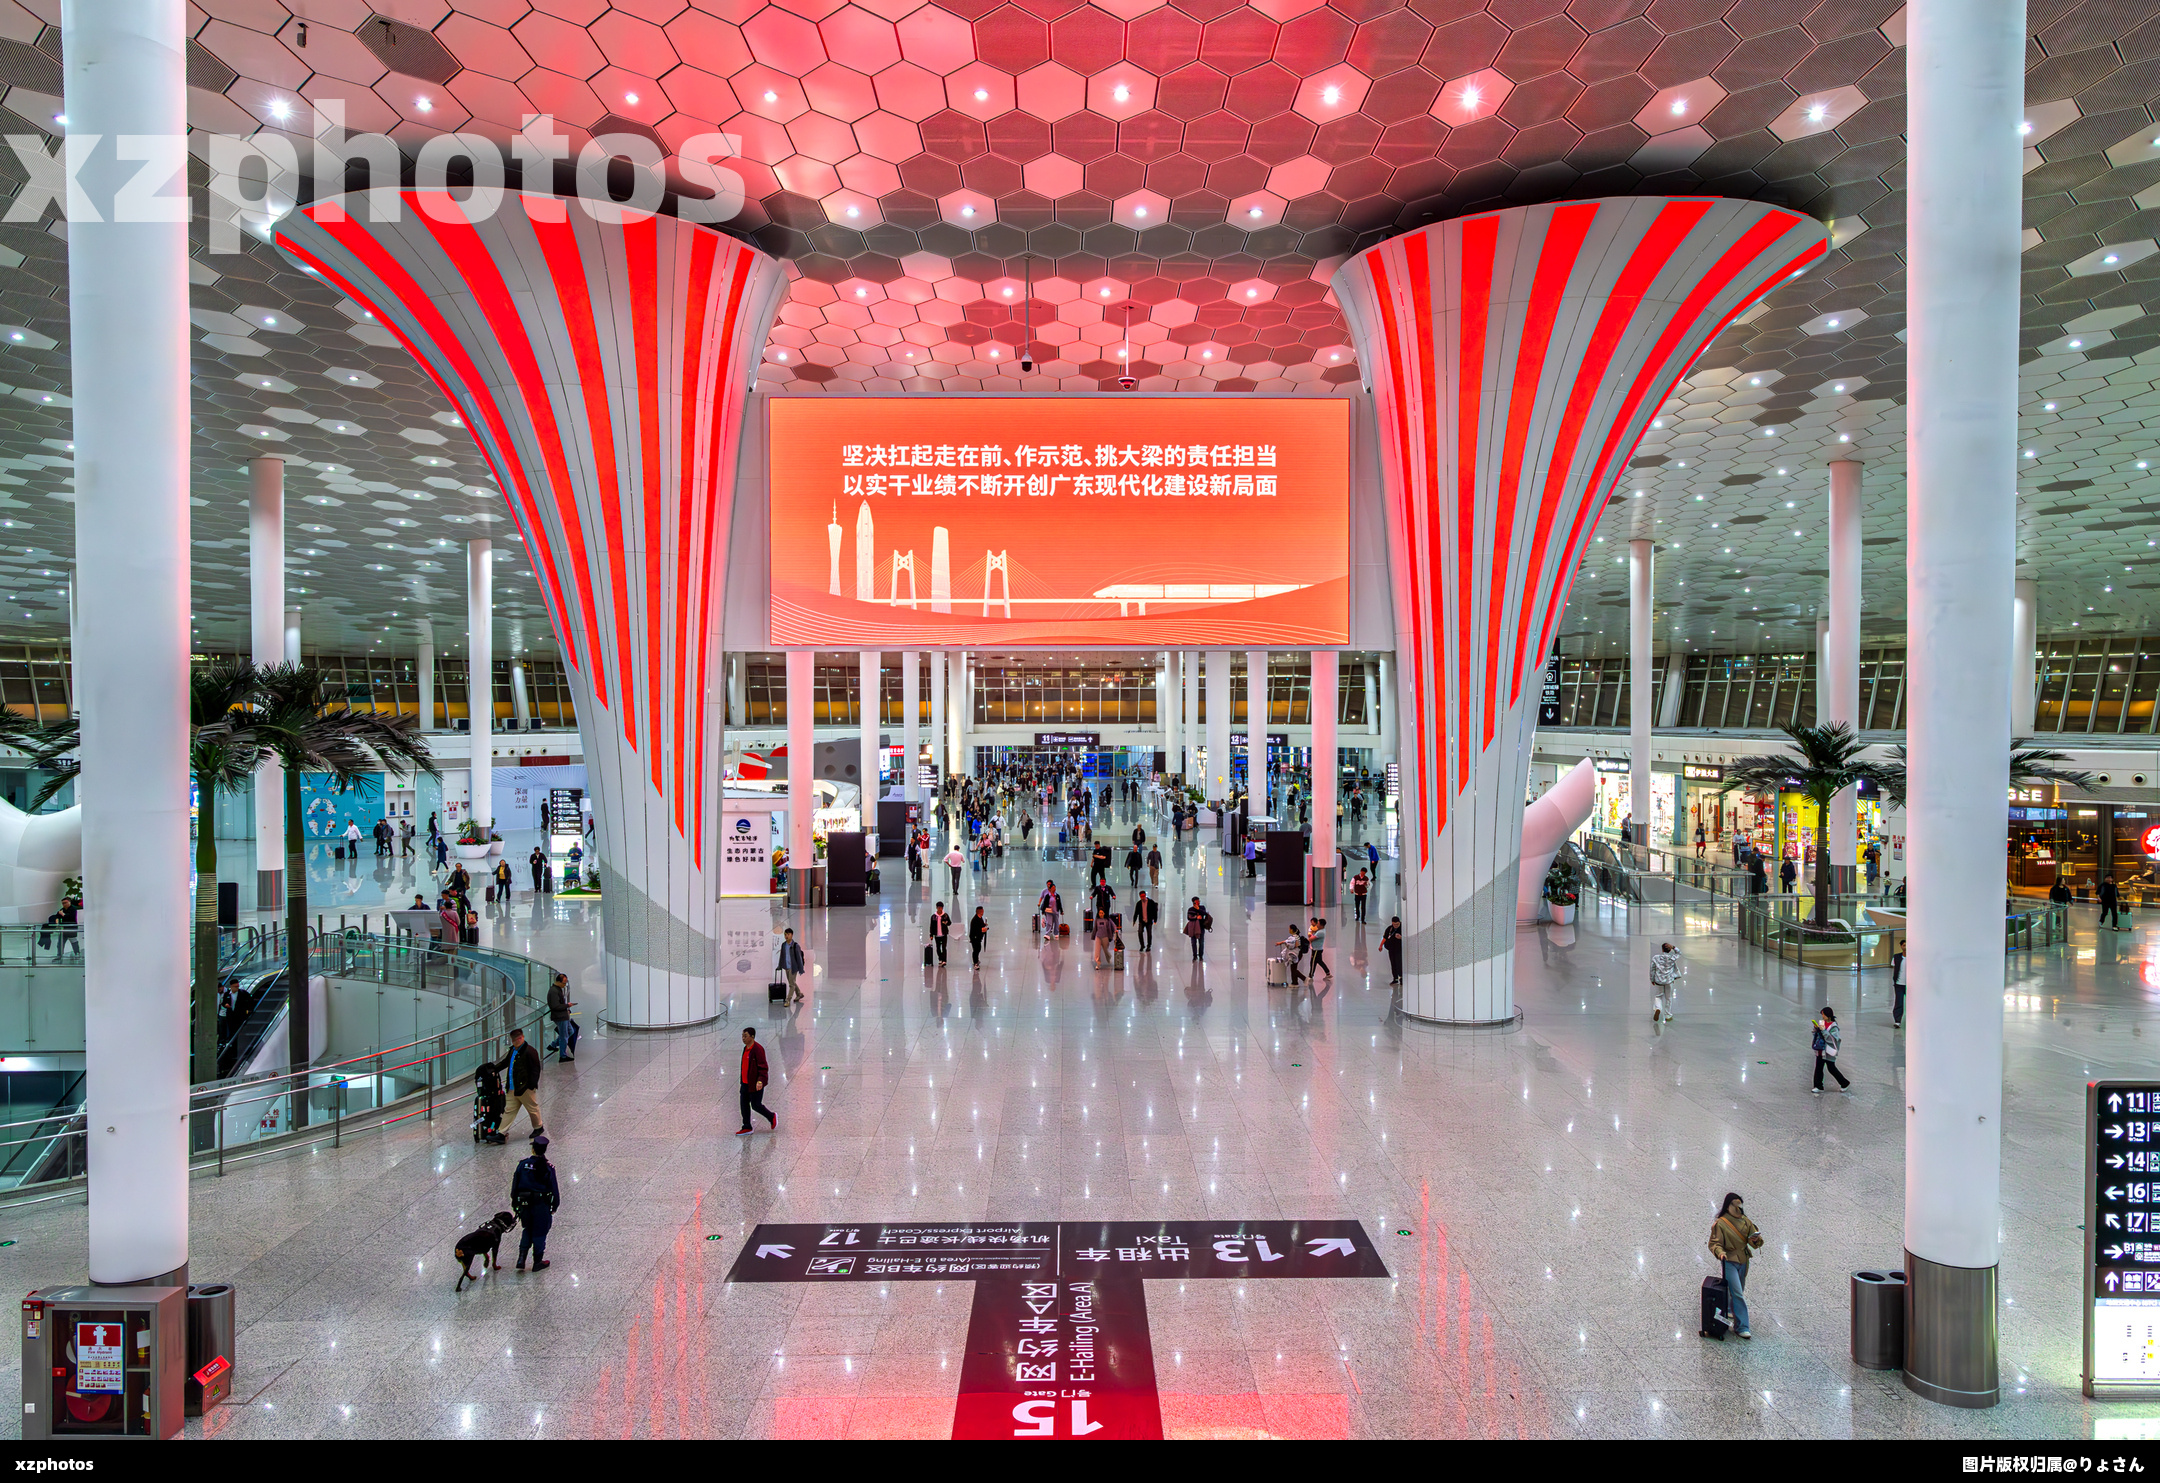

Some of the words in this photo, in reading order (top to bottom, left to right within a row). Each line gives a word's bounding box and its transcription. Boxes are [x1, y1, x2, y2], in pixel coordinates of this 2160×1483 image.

[842, 444, 1277, 468] 坚决扛起走在前、作示范、挑大梁的责任担当
[842, 473, 1277, 497] 以实干业绩不断开创广东现代化建设新局面
[2126, 1092, 2145, 1109] 11
[2126, 1121, 2146, 1138] 13
[2125, 1151, 2146, 1168] 14
[2126, 1182, 2146, 1199] 16
[2125, 1212, 2145, 1228] 17
[818, 1232, 861, 1246] 17
[876, 1234, 1051, 1246] 机场快线/长途巴士
[882, 1227, 974, 1236] Express/Coach
[1135, 1235, 1189, 1246] Taxi
[2123, 1242, 2136, 1252] B1
[1075, 1247, 1190, 1262] 出租车
[1211, 1240, 1285, 1262] 13
[1015, 1283, 1059, 1382] 网约车A区
[1068, 1326, 1099, 1381] E-Hailing
[1023, 1389, 1057, 1397] Gate
[1061, 1389, 1092, 1397] 号门
[1012, 1399, 1104, 1437] 15
